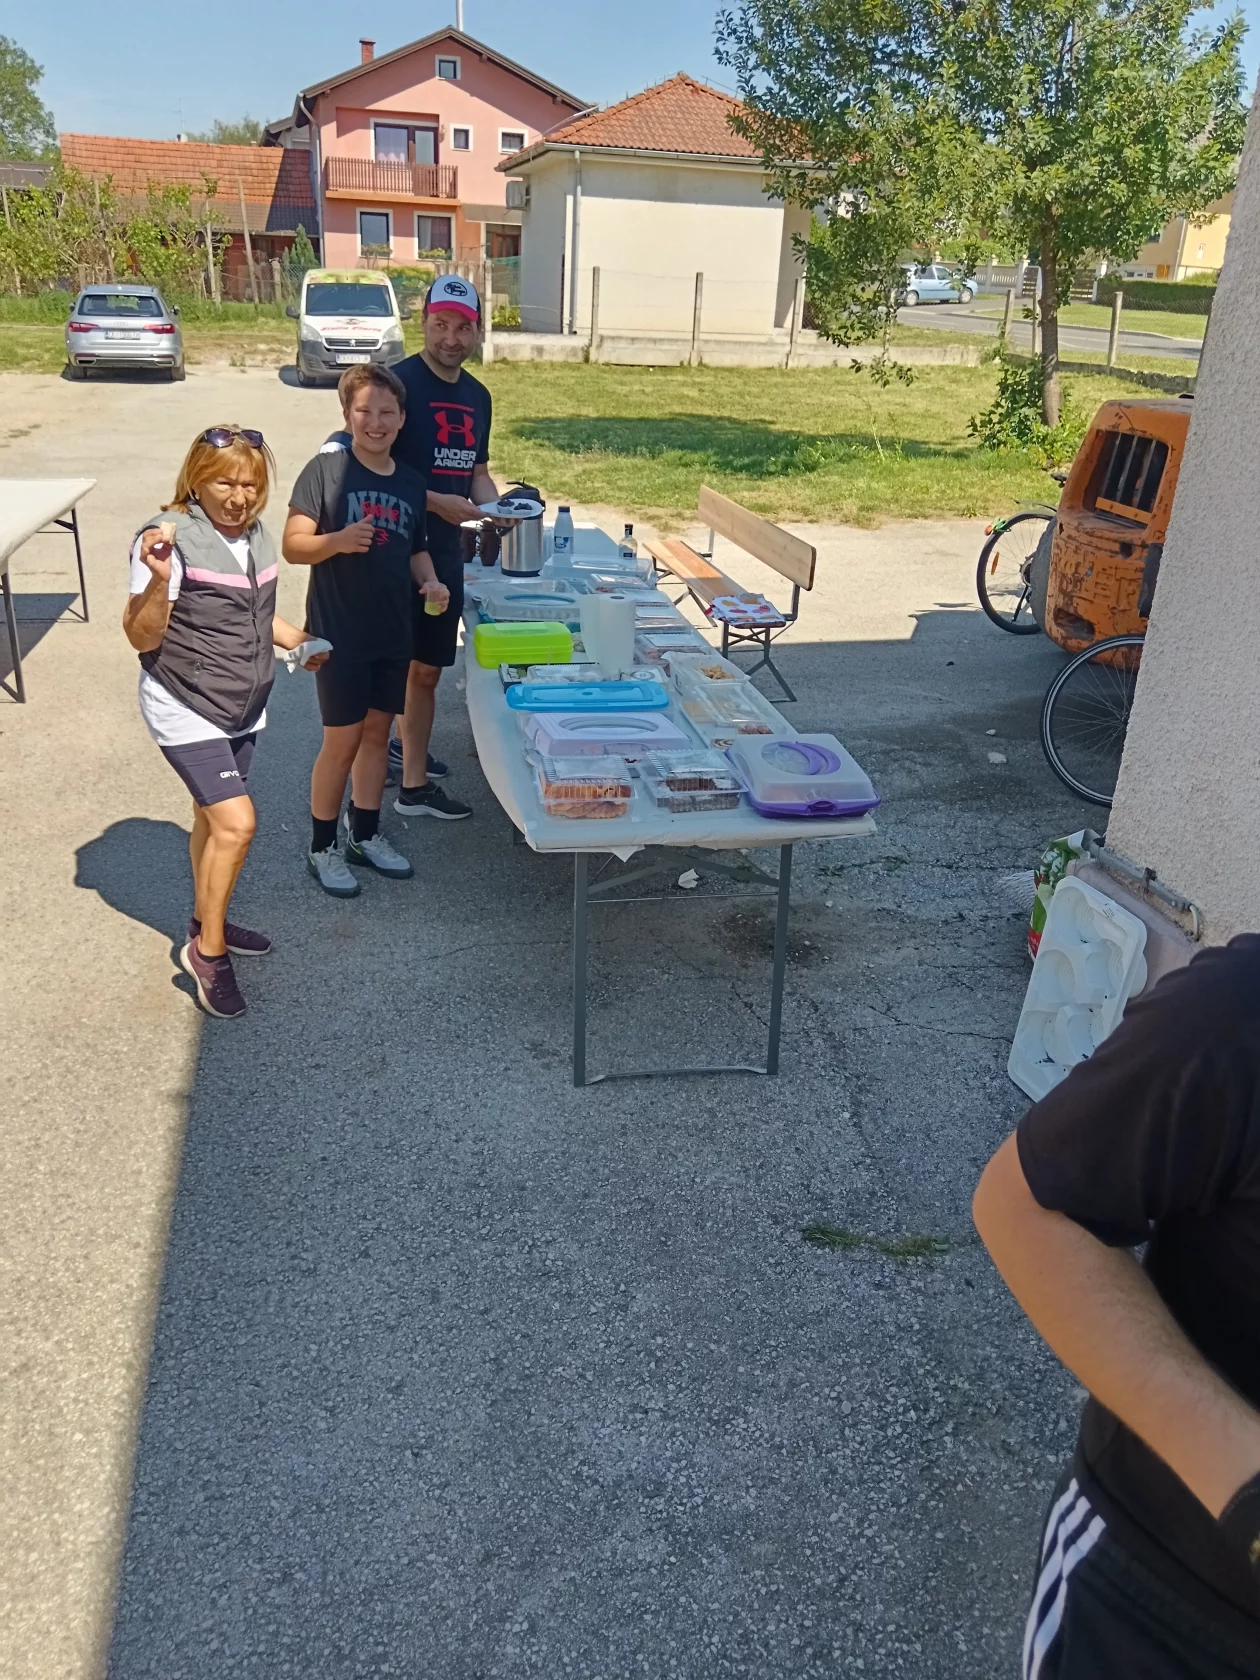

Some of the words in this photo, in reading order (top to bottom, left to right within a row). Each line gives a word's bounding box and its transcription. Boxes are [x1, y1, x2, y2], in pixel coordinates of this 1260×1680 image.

[434, 447, 476, 461] UNDER
[434, 458, 473, 468] ARMOUR
[345, 490, 412, 539] NIKE
